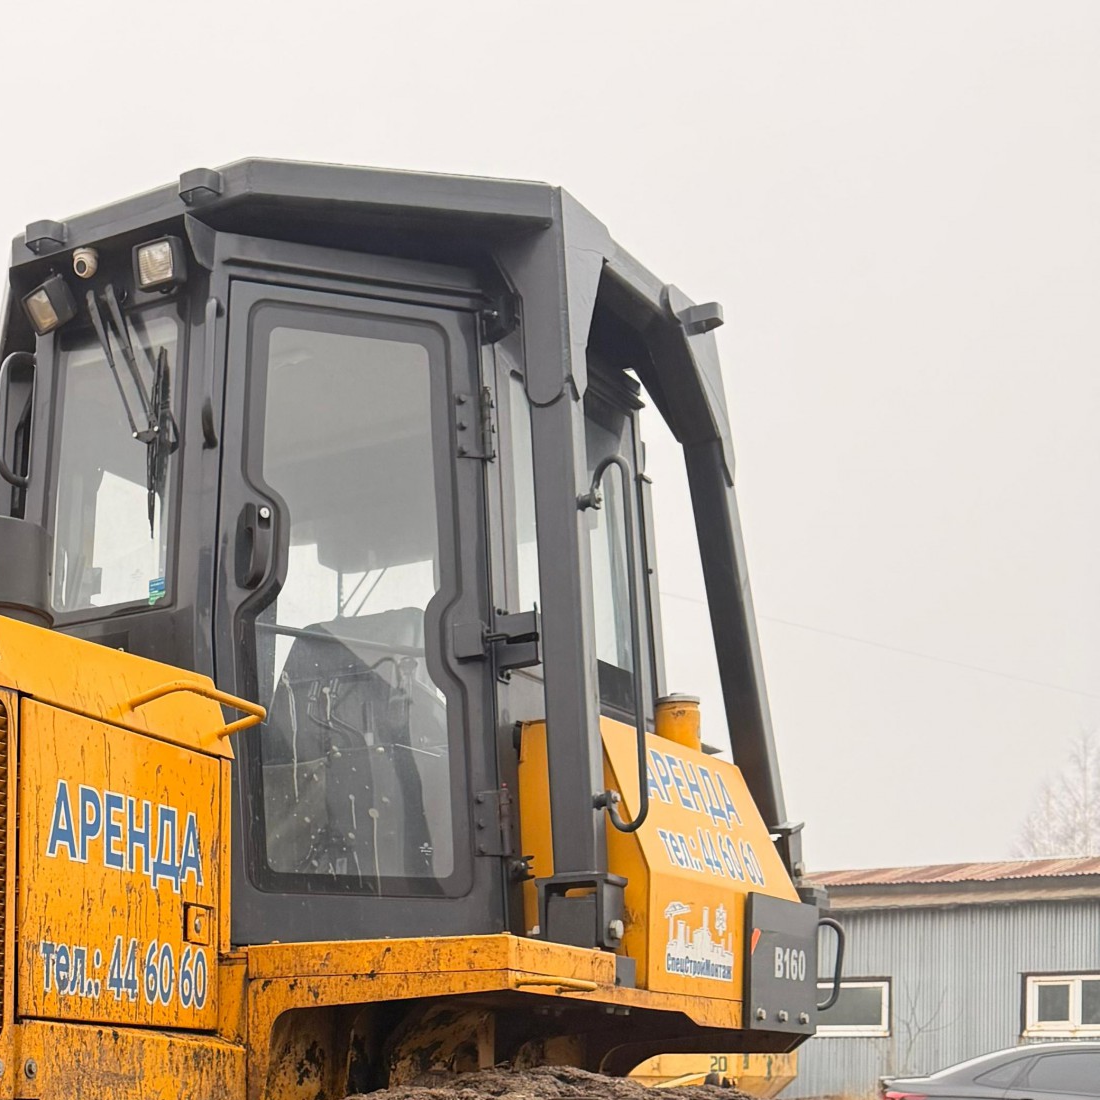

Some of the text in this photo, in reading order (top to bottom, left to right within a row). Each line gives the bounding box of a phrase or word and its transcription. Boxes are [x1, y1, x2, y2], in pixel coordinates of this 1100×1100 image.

[647, 749, 742, 830] АРЕНДА
[46, 779, 204, 894] АРЕНДА
[657, 827, 765, 888] тел.: 44 60 60
[41, 935, 207, 1010] тел.: 44 60 60
[774, 946, 806, 981] B160
[710, 1055, 728, 1073] 20
